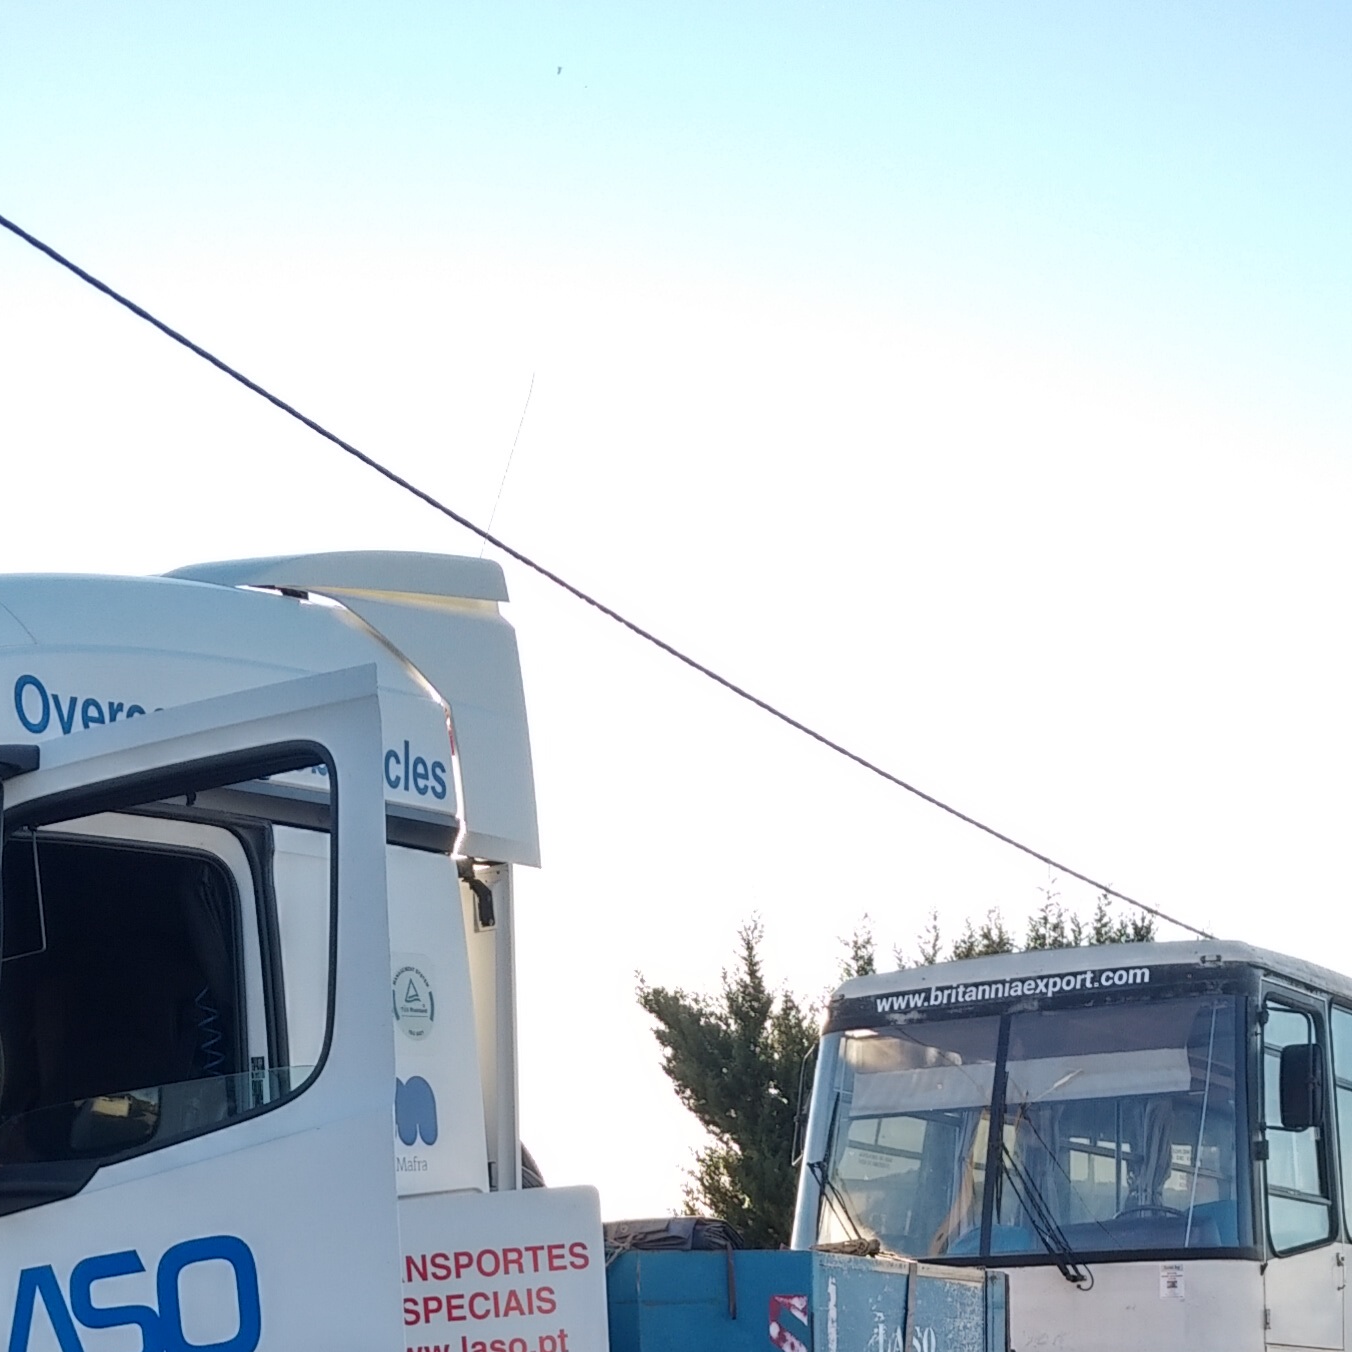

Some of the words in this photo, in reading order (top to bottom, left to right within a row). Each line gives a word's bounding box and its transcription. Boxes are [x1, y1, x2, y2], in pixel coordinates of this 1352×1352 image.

[14, 674, 164, 735] Over
[384, 739, 447, 800] cles
[876, 967, 1151, 1013] www.britanniaexport.com
[396, 1156, 428, 1172] Mafra
[402, 1242, 590, 1284] NSPORTES
[403, 1286, 557, 1326] SPECIAIS
